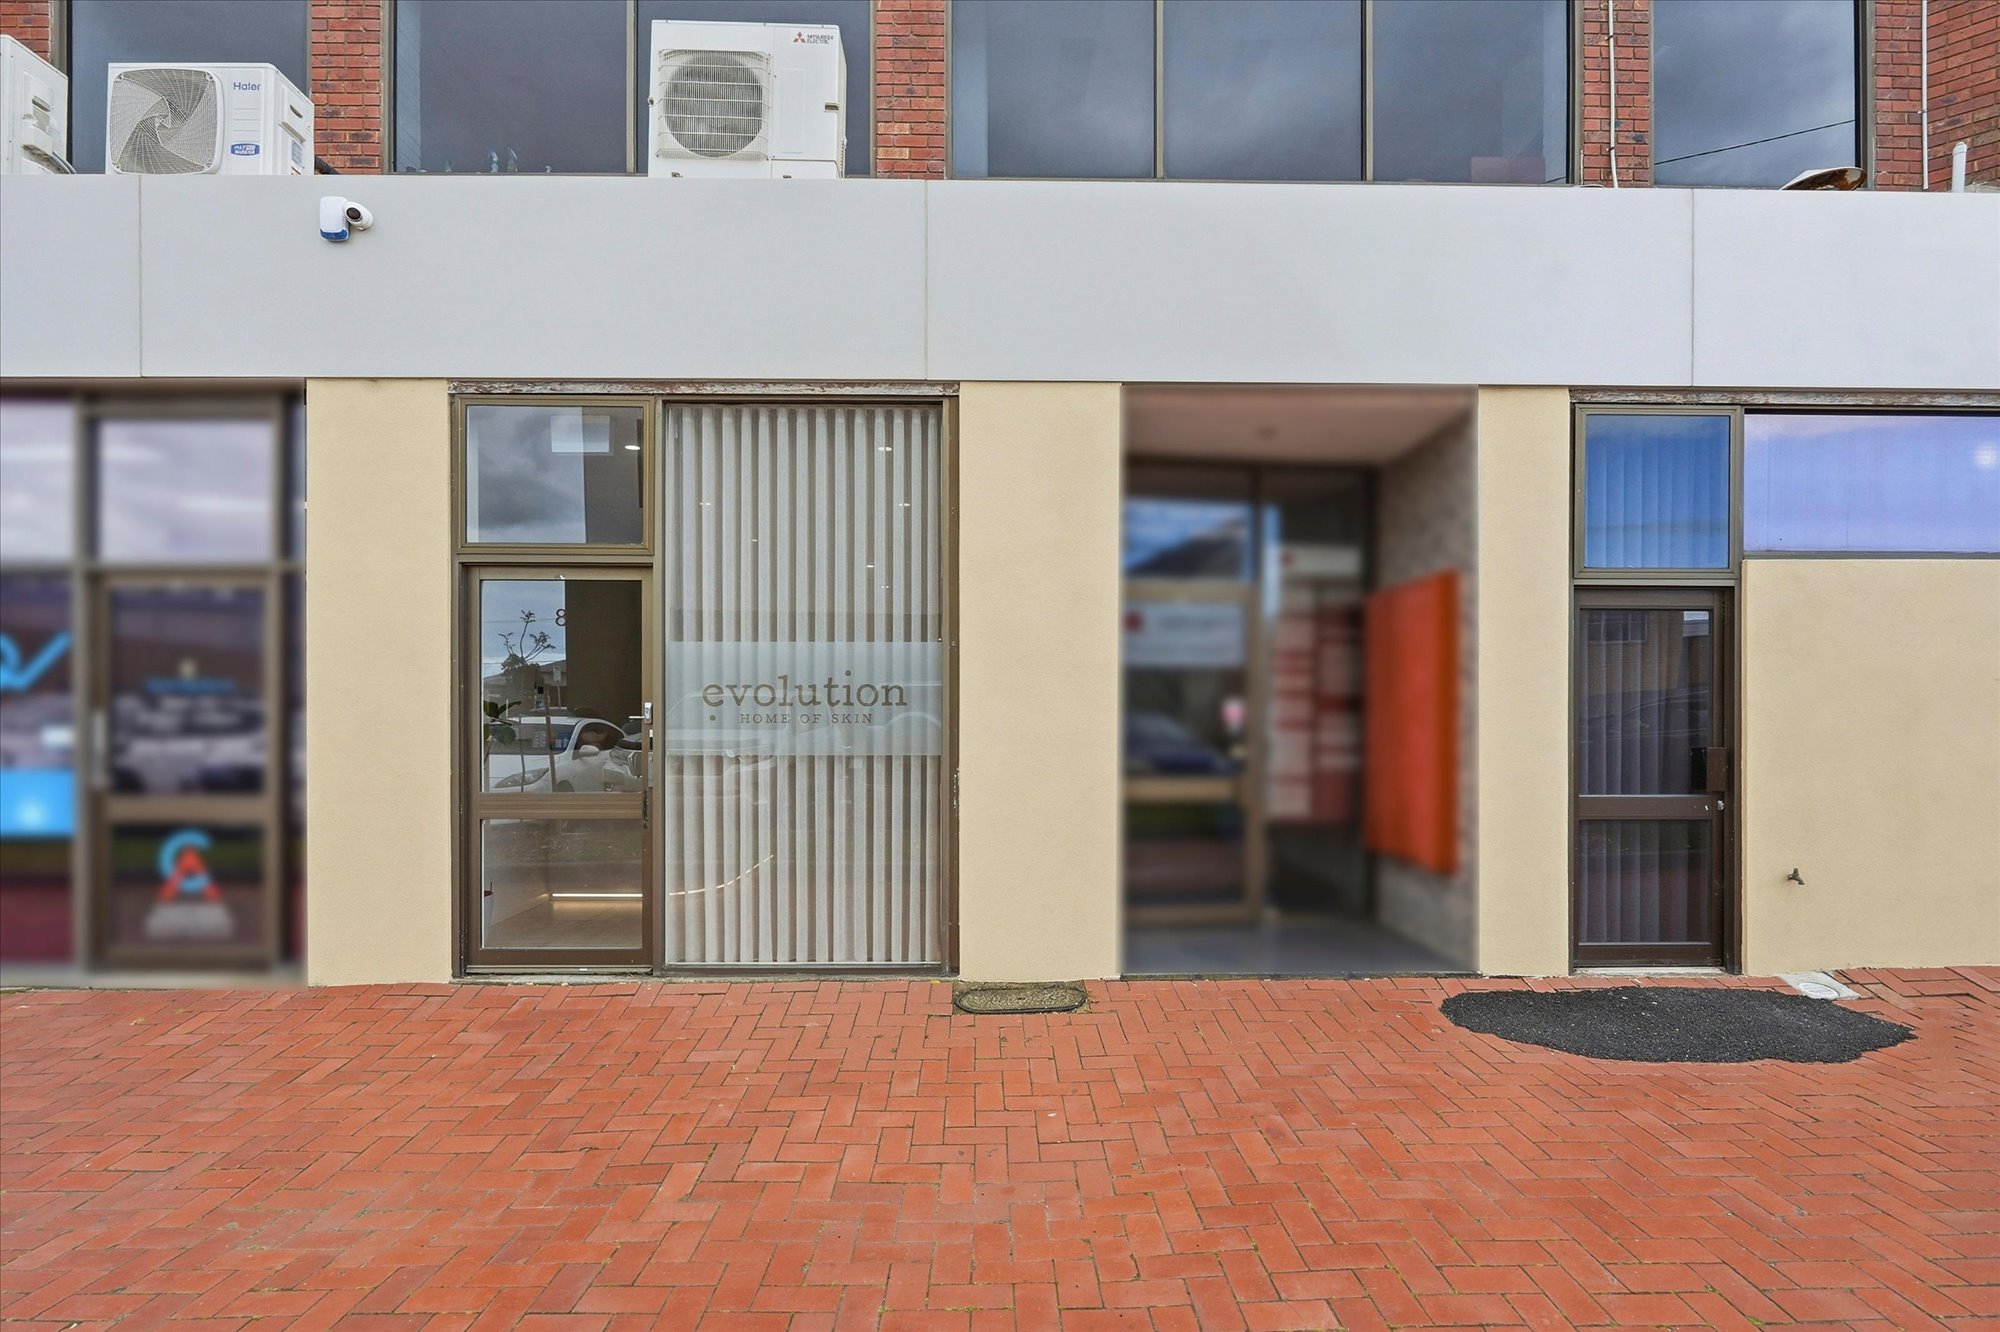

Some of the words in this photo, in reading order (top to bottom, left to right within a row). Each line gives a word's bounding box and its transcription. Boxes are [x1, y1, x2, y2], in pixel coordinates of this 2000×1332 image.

[233, 82, 261, 91] Haier
[555, 608, 567, 627] 8
[702, 670, 908, 708] evolution
[740, 713, 790, 724] HOME
[800, 713, 822, 724] OF
[831, 713, 873, 724] SKIN
